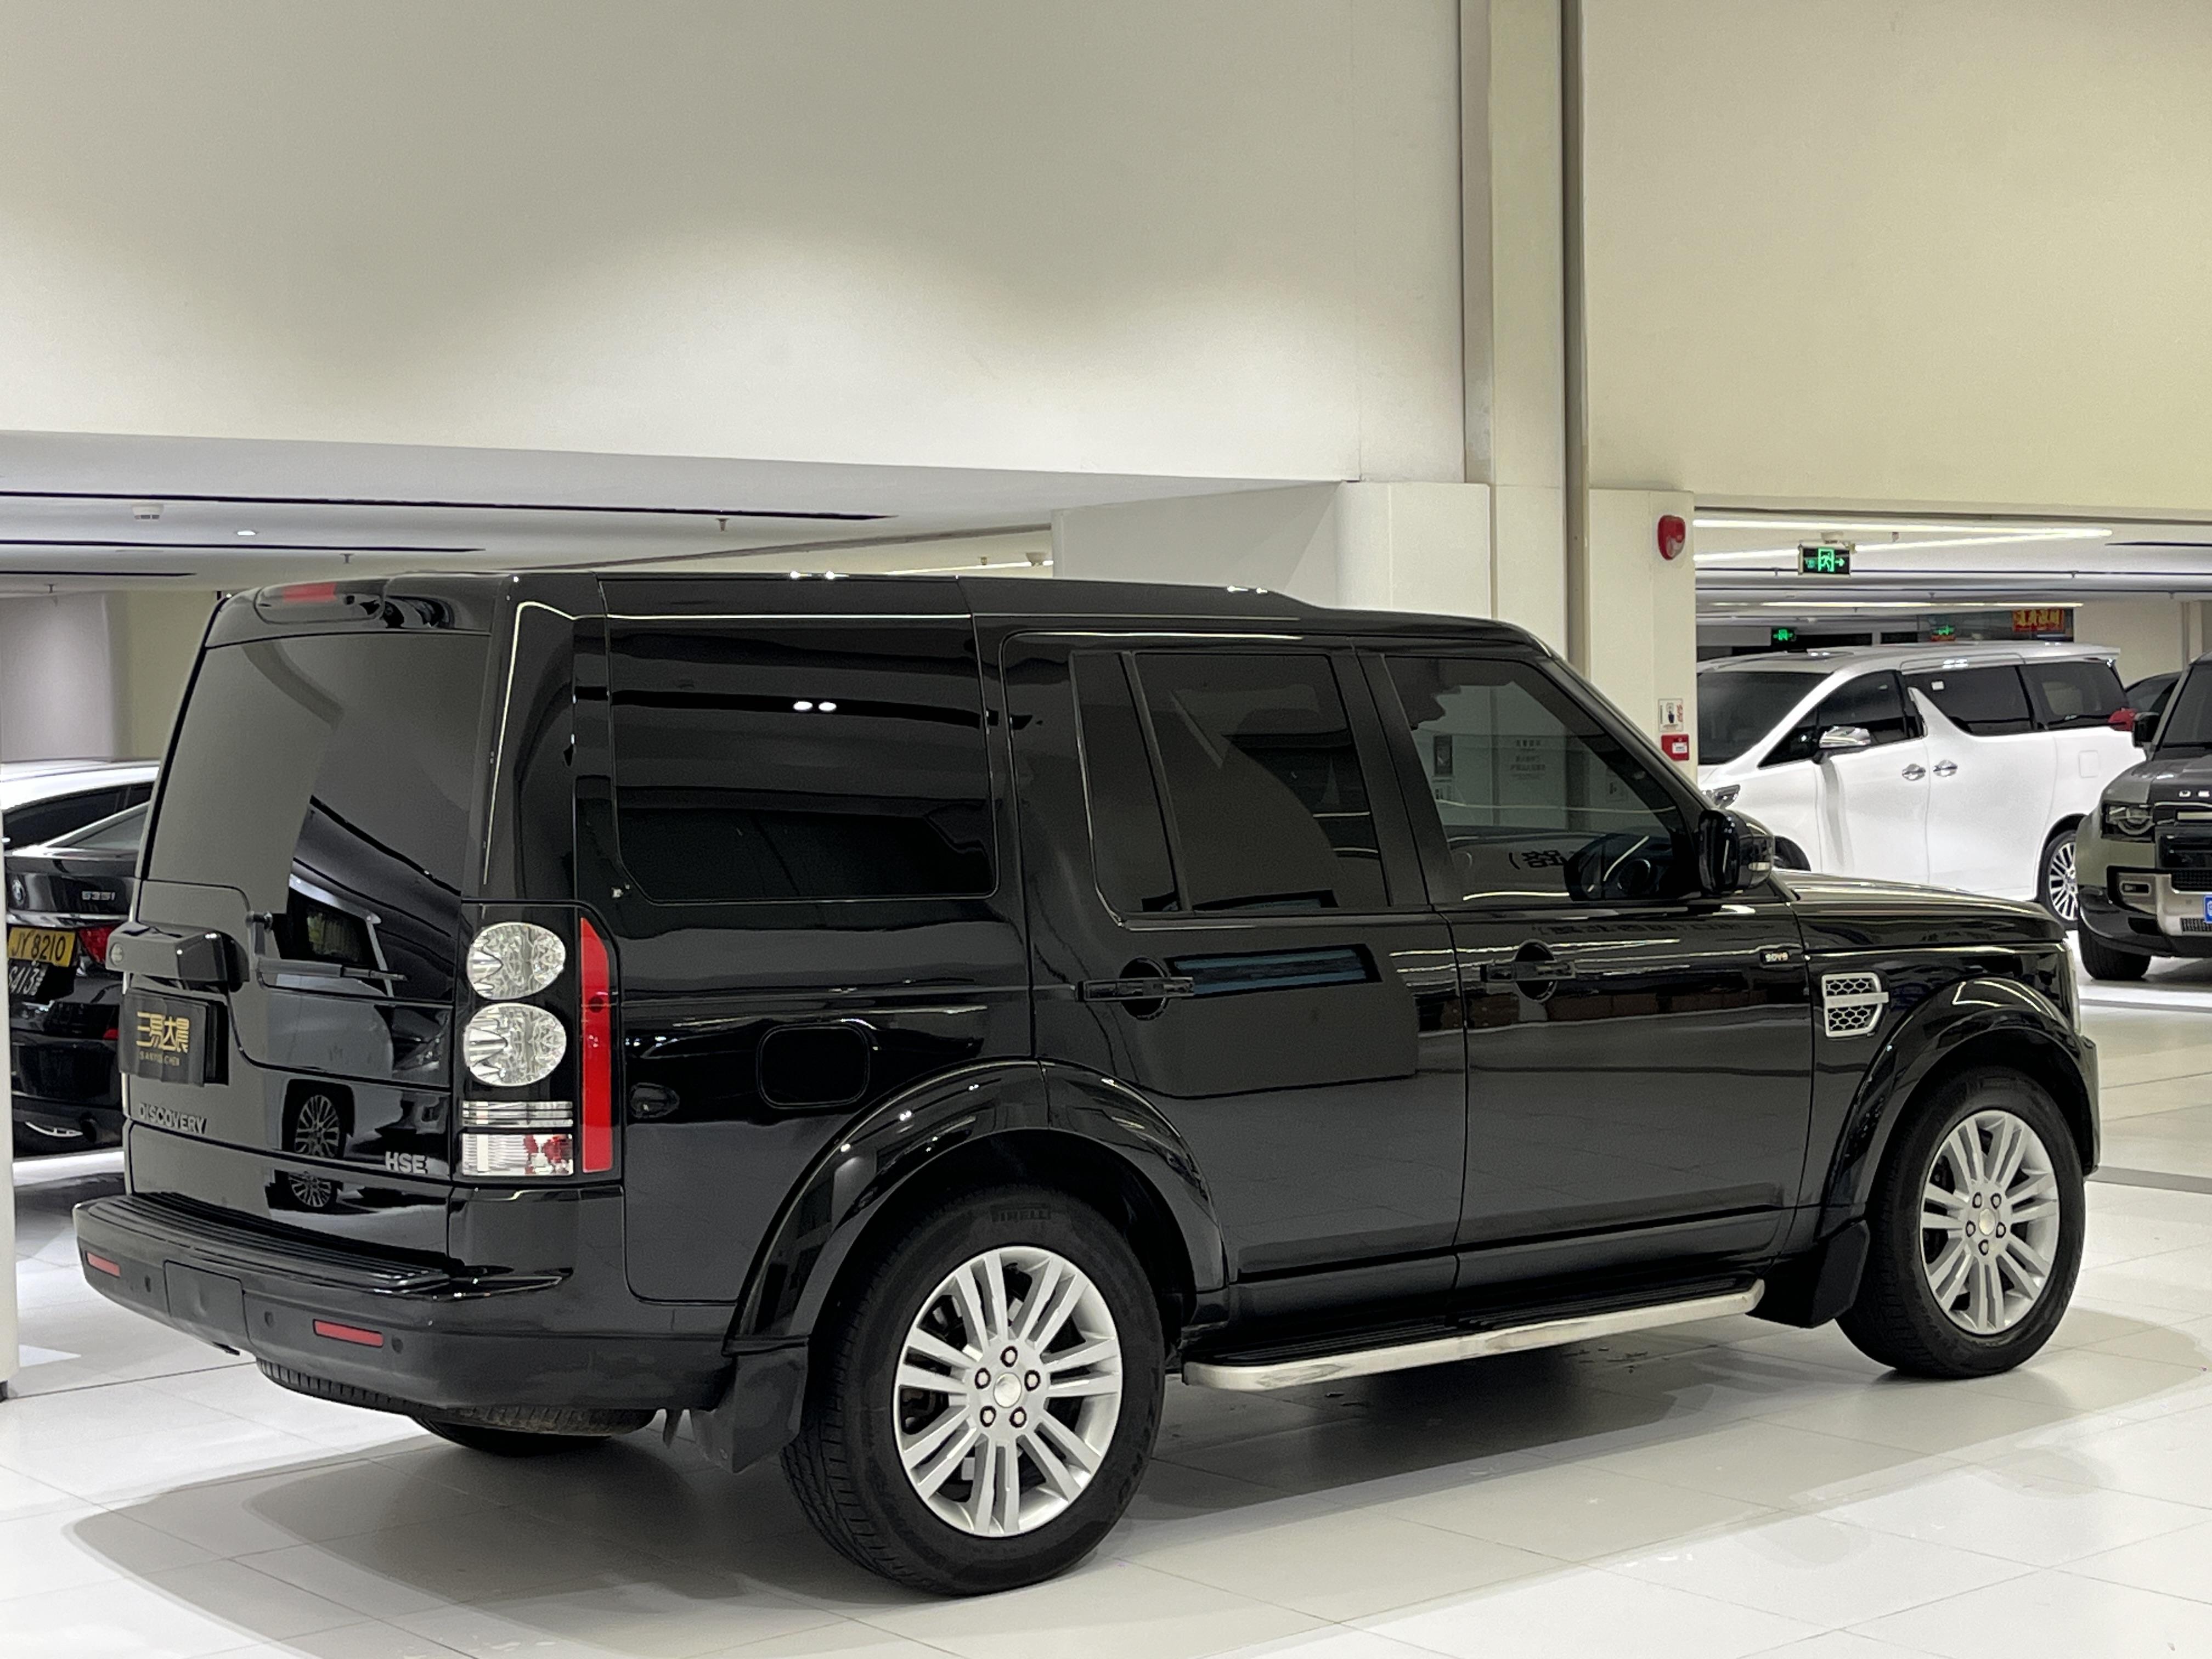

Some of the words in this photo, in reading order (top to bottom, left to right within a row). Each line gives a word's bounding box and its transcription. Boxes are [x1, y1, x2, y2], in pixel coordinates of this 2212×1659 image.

[31, 934, 66, 961] 8210
[139, 1103, 207, 1135] DISCOVERY
[385, 1150, 426, 1175] HSE
